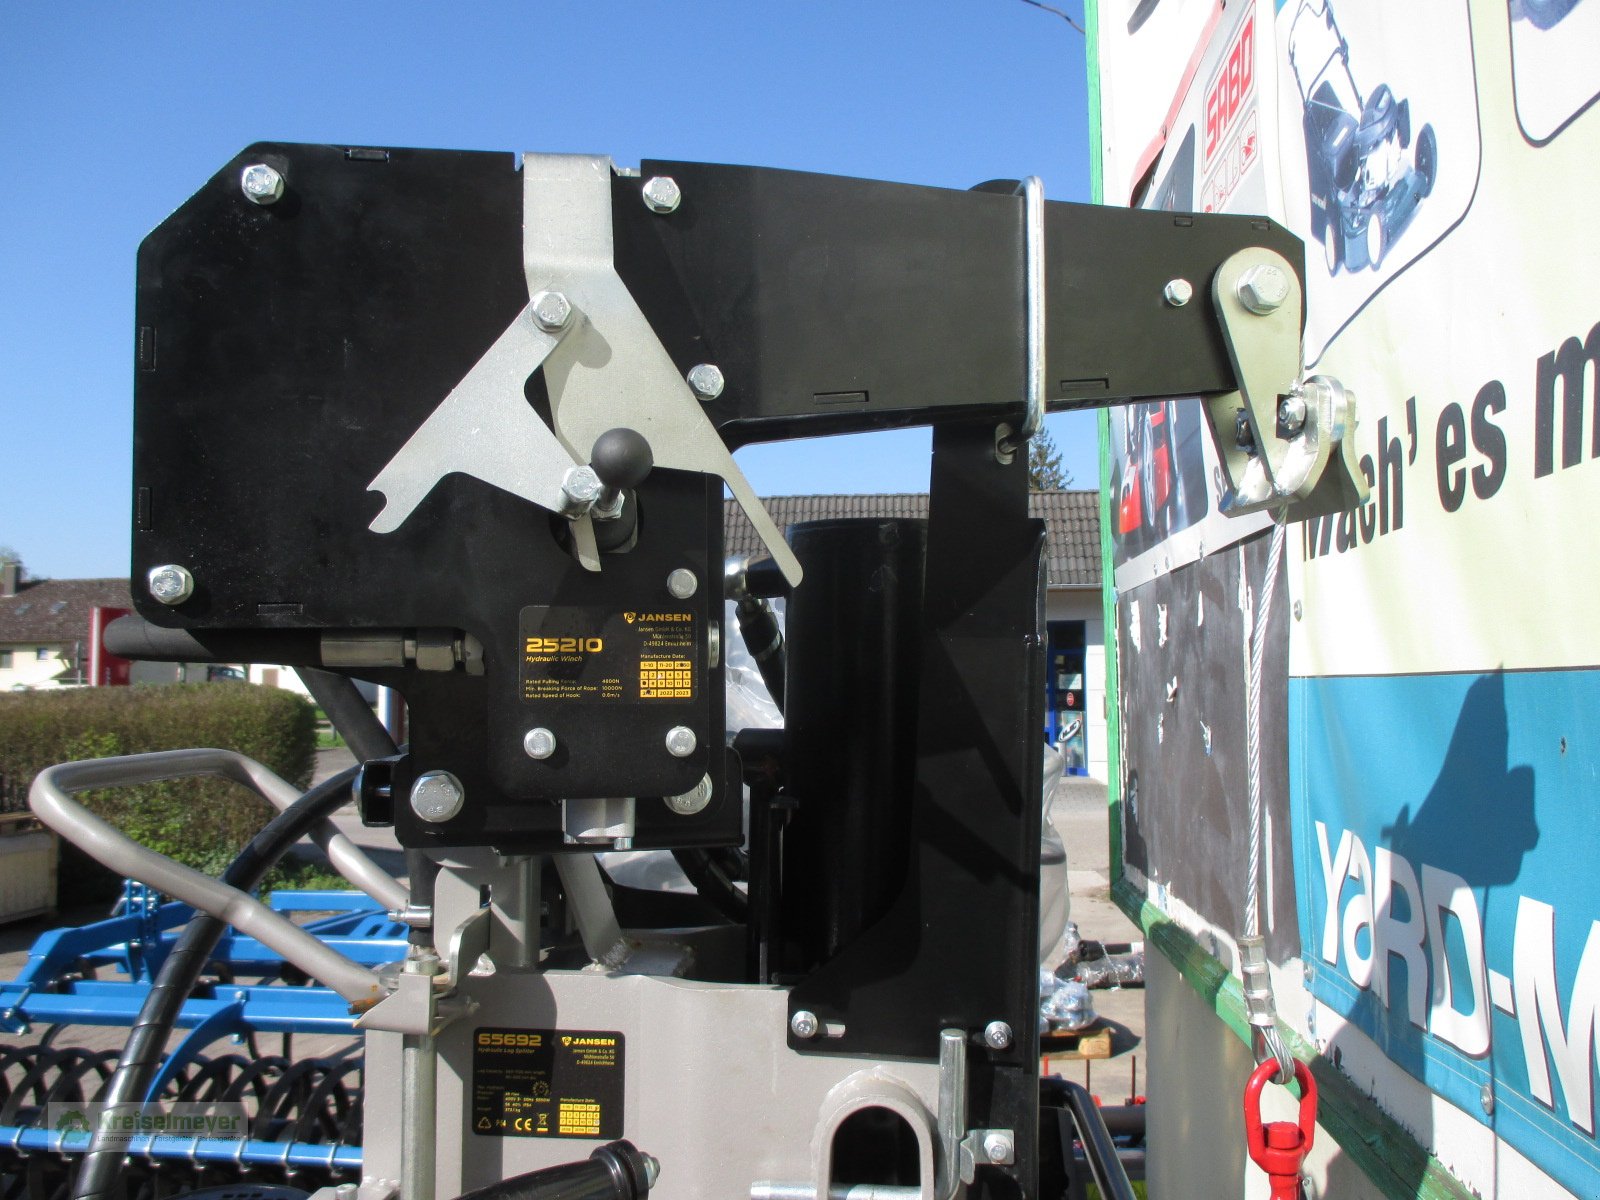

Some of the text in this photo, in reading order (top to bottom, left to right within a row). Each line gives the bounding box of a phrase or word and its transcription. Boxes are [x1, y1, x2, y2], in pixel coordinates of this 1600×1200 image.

[1206, 16, 1253, 162] SABO
[1436, 379, 1507, 513] es
[638, 613, 692, 621] JANSEN
[526, 638, 603, 653] 25210
[479, 1034, 542, 1047] 65692
[573, 1038, 615, 1046] JANSEN
